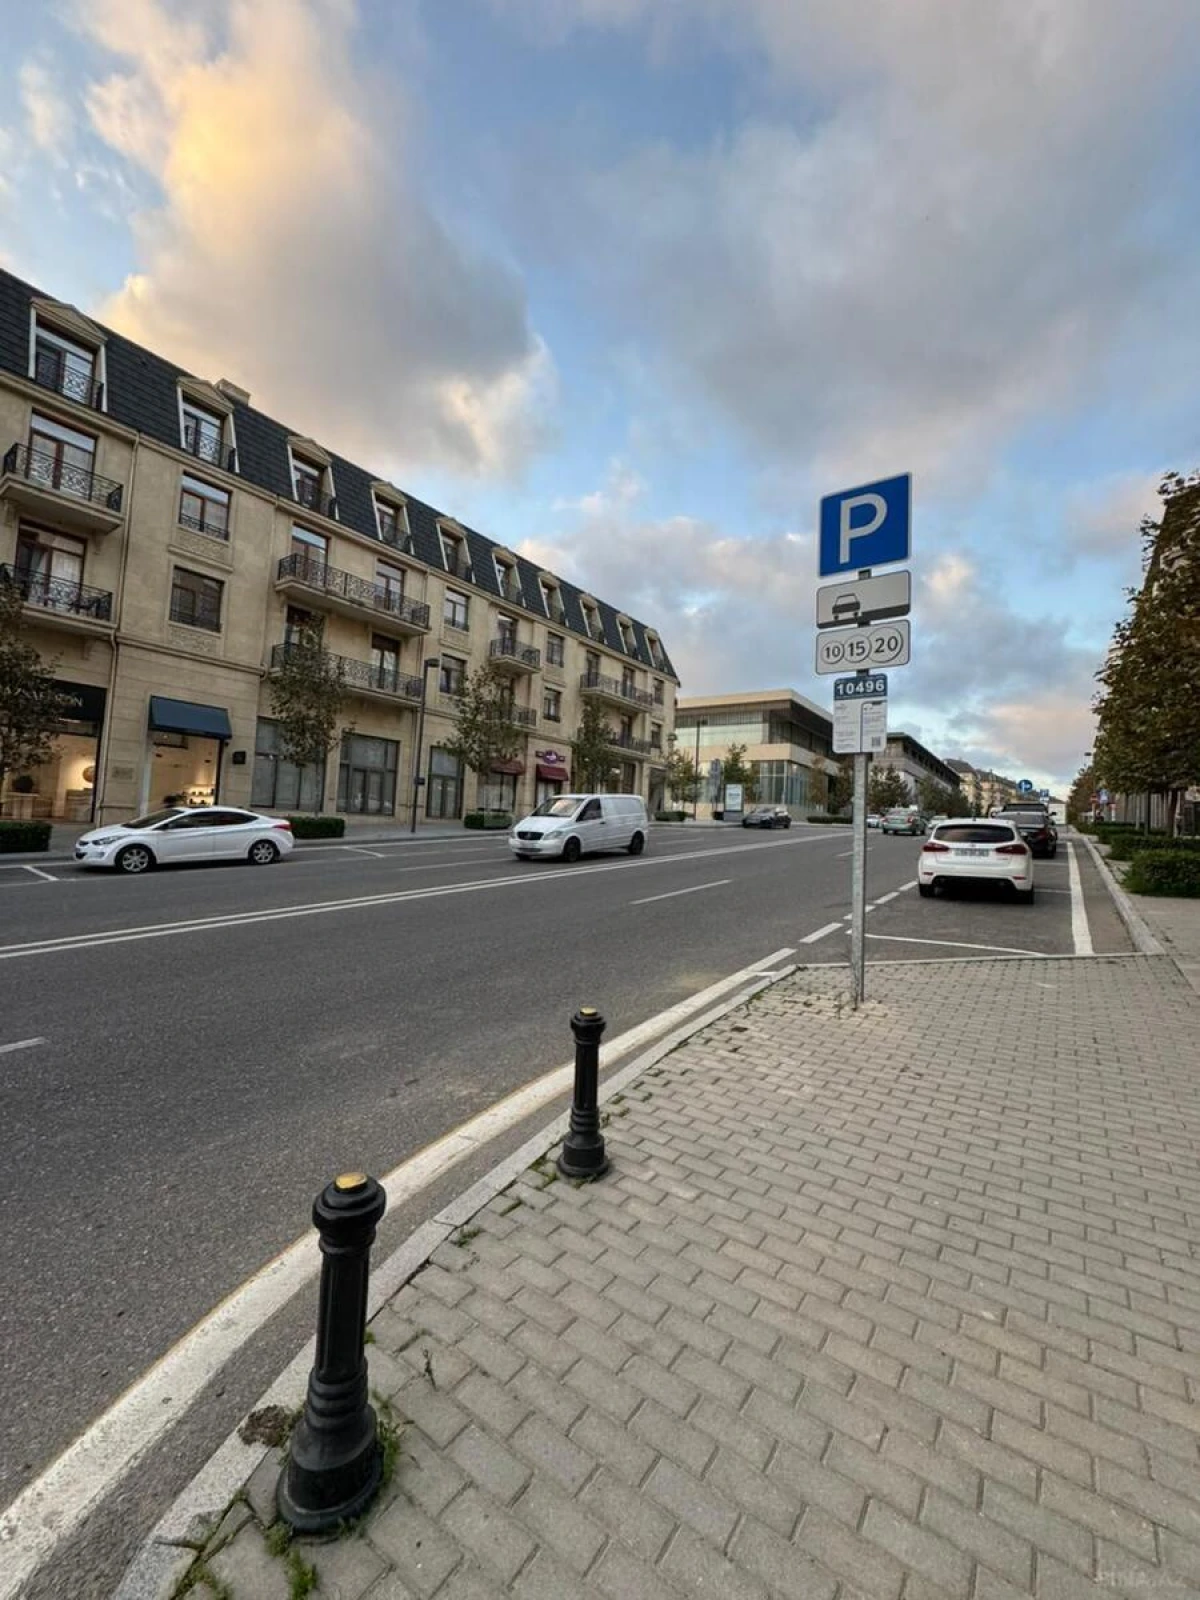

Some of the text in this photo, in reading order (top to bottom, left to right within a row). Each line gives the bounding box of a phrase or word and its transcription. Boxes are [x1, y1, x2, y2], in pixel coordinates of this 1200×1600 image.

[839, 492, 888, 565] P
[825, 635, 898, 659] 10 15 20
[837, 679, 885, 695] 10496
